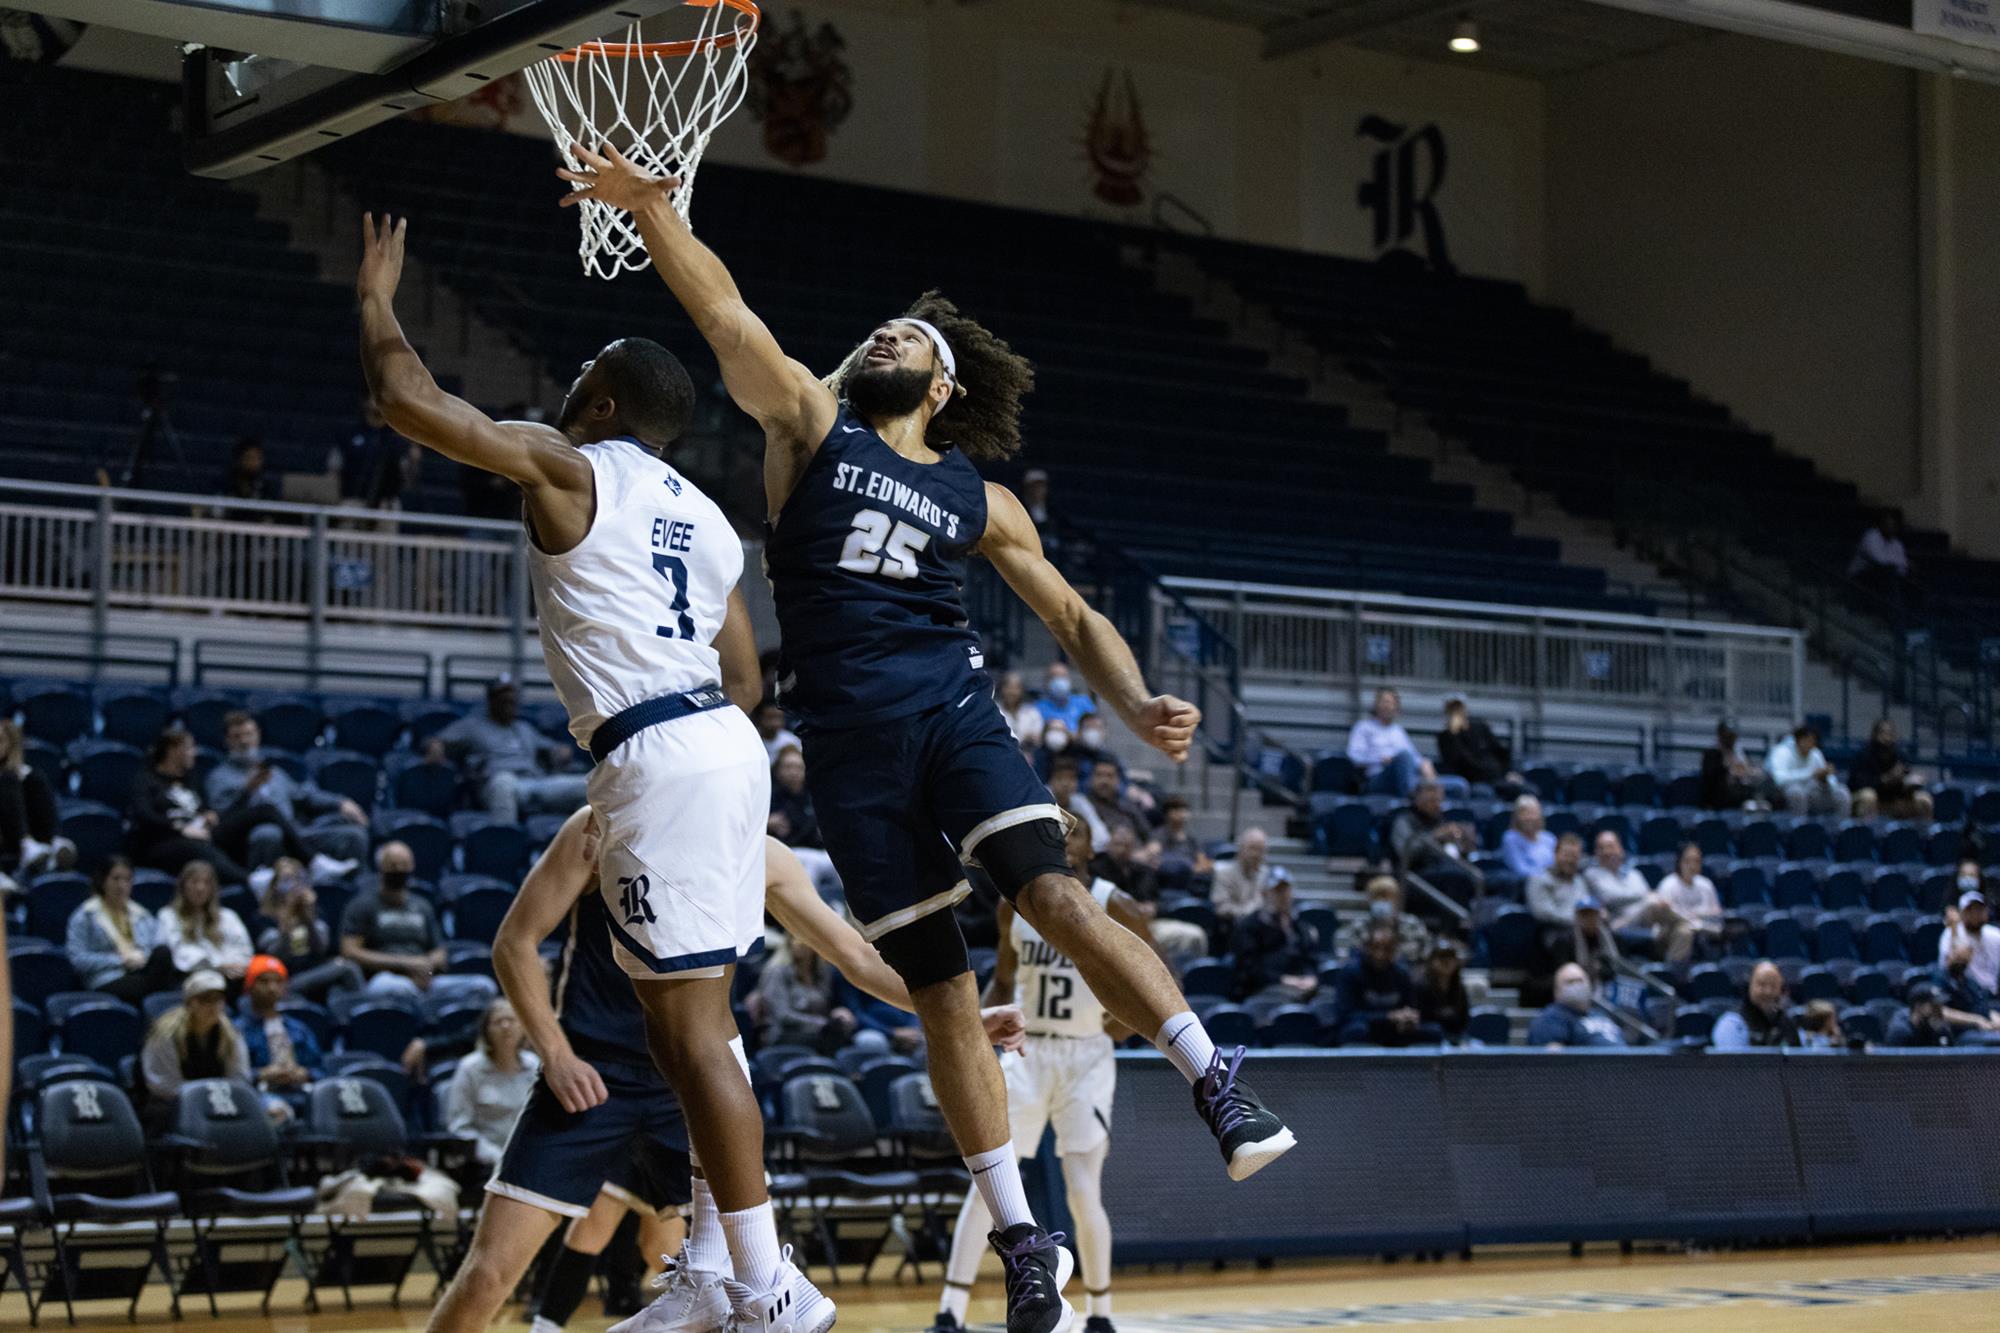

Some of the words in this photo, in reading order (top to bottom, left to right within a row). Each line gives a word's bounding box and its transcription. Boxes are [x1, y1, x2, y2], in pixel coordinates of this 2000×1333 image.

[651, 517, 695, 553] EVEE
[837, 508, 931, 580] 25
[616, 874, 658, 928] R
[1036, 973, 1073, 1020] 12
